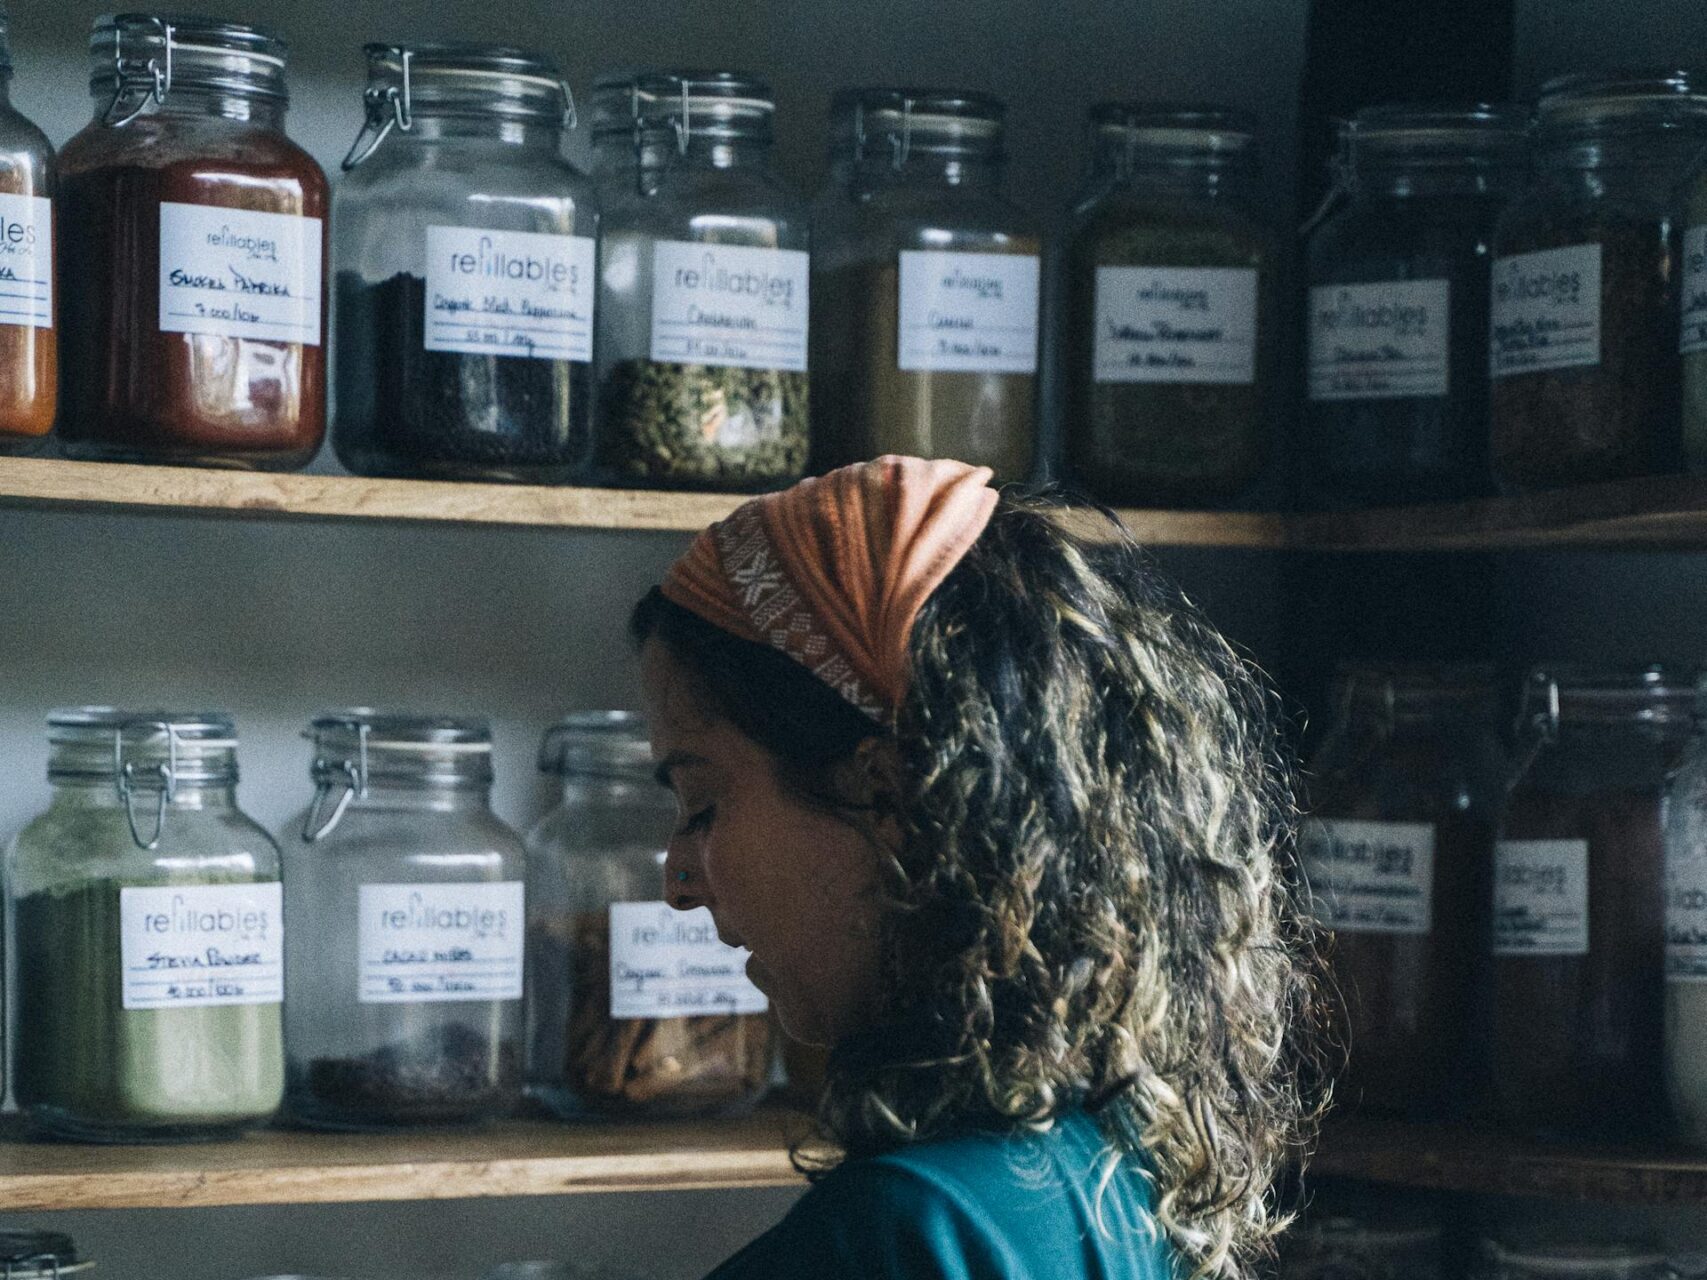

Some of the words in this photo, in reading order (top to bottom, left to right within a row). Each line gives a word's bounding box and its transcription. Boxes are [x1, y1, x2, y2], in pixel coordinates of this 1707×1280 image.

[207, 224, 277, 251] refillables
[450, 236, 579, 284] refillables
[144, 895, 268, 933] refillables
[382, 891, 507, 930] refillables
